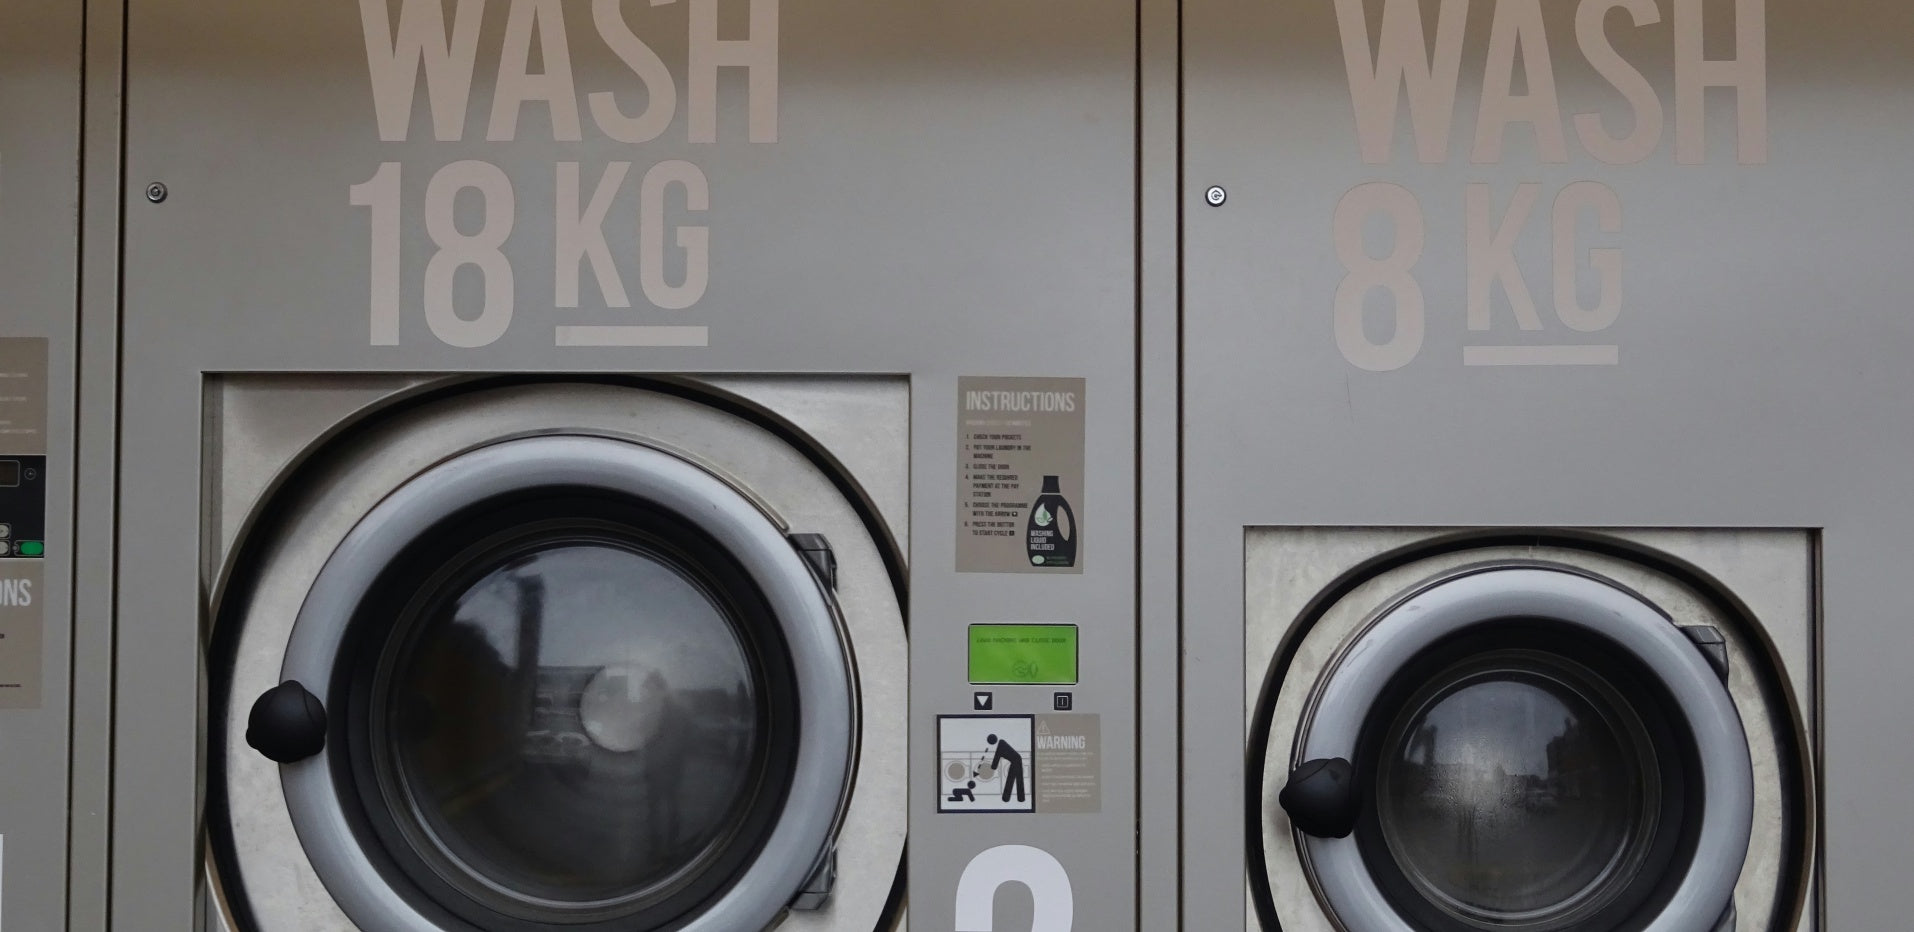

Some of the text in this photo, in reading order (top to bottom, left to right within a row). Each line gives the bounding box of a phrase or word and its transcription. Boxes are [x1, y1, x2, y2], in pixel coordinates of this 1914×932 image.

[358, 0, 779, 144] WASH
[1334, 0, 1768, 166] WASH
[350, 160, 709, 348] 18 KG
[1332, 180, 1624, 372] 8 KG
[965, 391, 1075, 412] INSTRUCTIONS
[1037, 735, 1086, 750] WARNING
